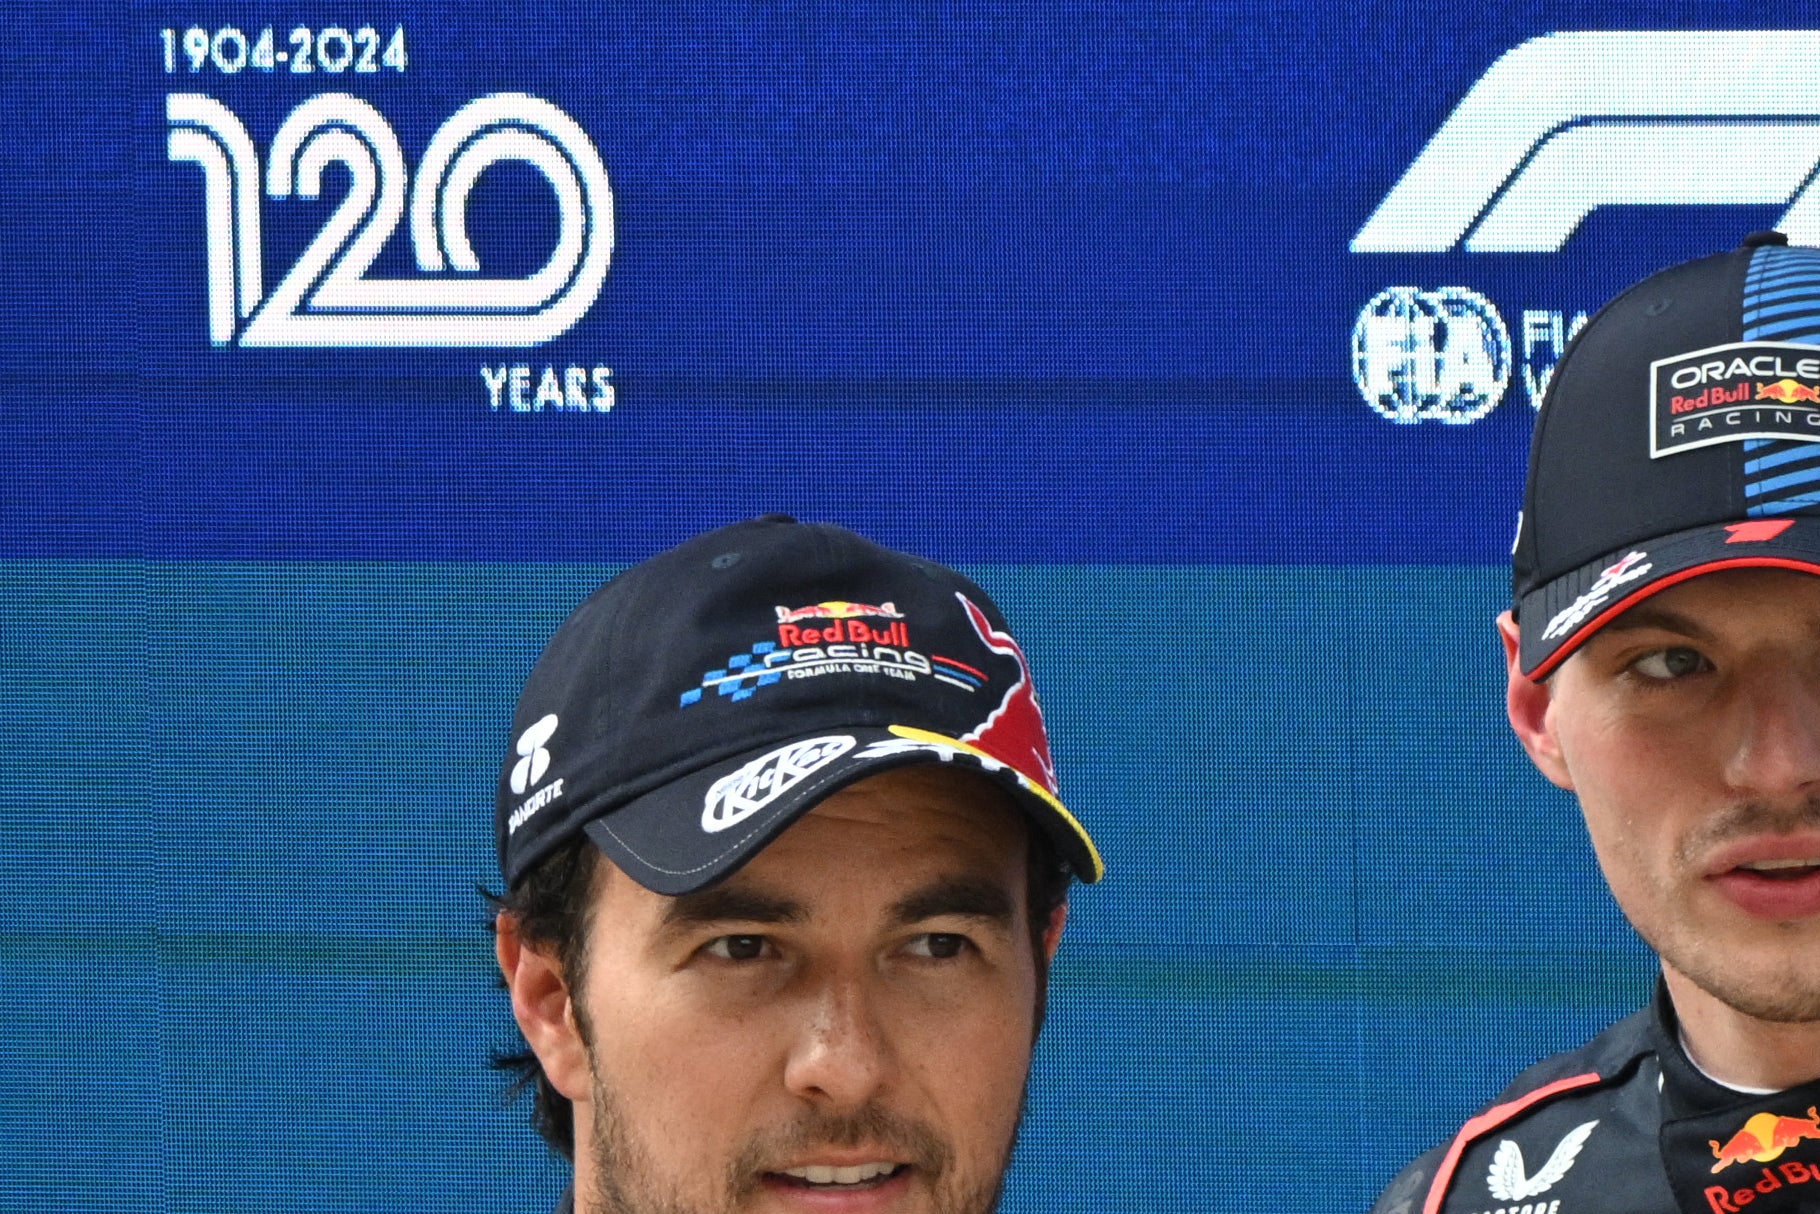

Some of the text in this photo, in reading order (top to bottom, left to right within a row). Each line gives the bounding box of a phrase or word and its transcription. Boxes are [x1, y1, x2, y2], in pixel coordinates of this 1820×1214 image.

[161, 26, 408, 73] 1904-2024
[166, 92, 614, 347] 120
[481, 364, 615, 412] YEARS
[1671, 382, 1749, 414] Red Bull
[778, 619, 910, 648] Red Bull
[764, 643, 932, 674] racing
[787, 664, 916, 681] FORMULA ONE TEAM
